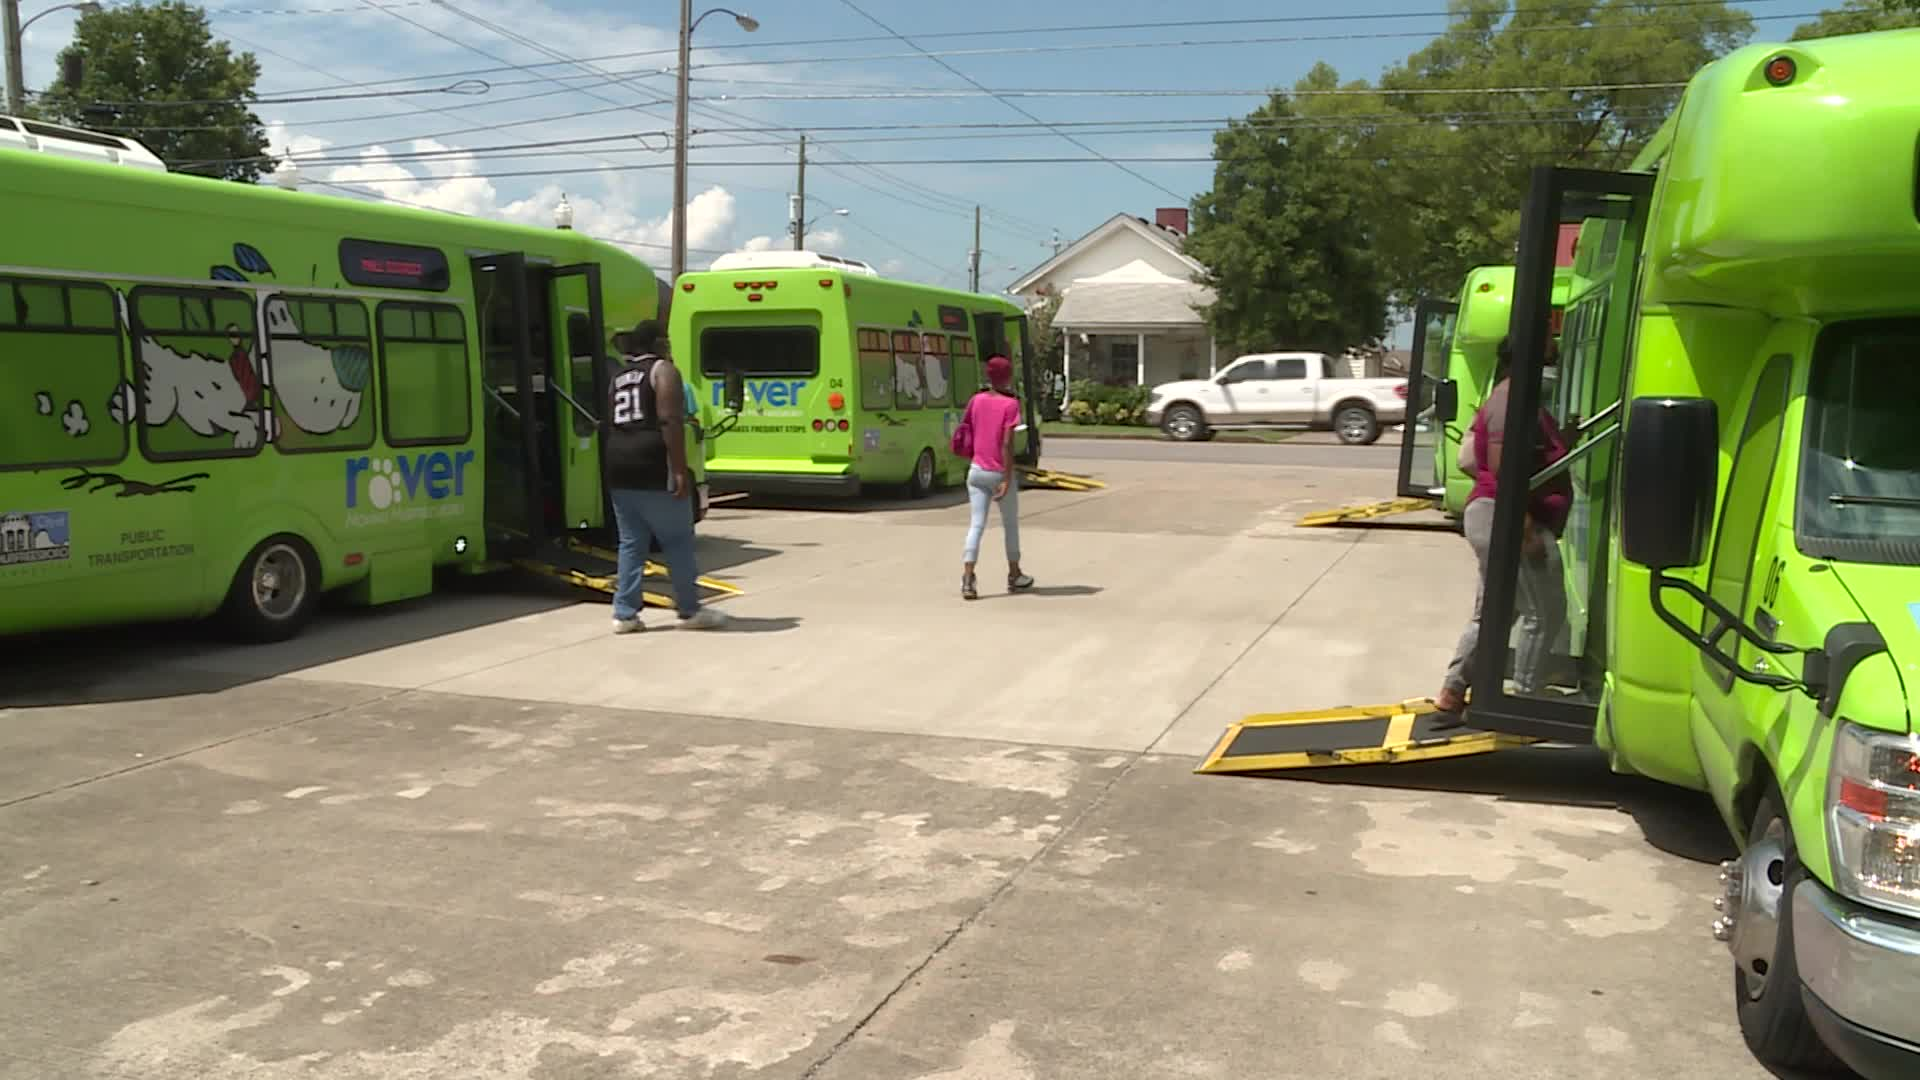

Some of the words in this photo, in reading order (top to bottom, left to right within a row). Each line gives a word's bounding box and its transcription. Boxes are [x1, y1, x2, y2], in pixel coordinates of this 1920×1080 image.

[614, 387, 644, 424] 21
[712, 380, 807, 407] rver
[120, 529, 165, 545] PUBLIC
[88, 544, 194, 567] TRANSPORTATION
